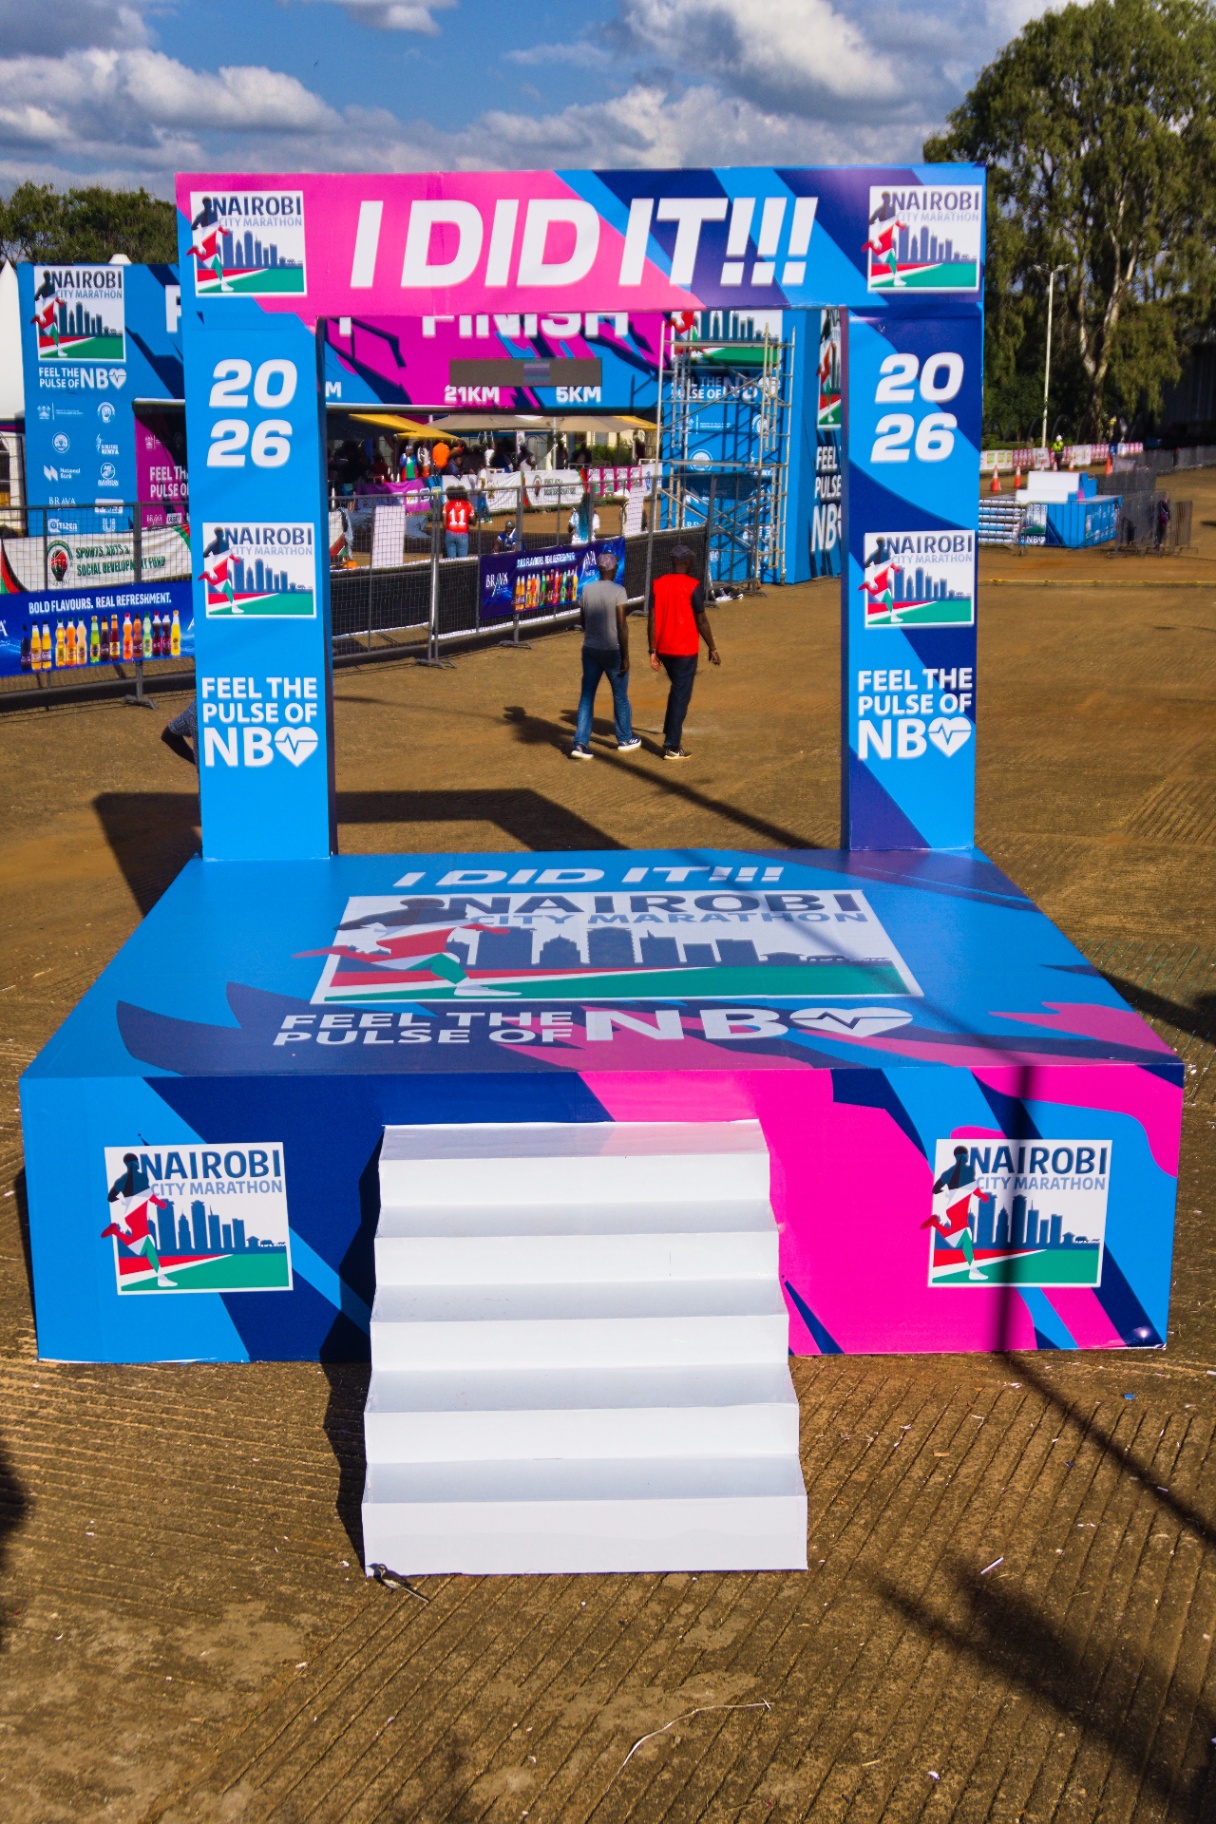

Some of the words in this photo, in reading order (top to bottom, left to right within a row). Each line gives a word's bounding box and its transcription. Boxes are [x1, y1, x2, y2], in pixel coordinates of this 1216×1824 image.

[212, 197, 302, 216] NAIROBI
[892, 191, 980, 211] NAIROBI
[219, 218, 241, 227] CITY
[244, 217, 302, 227] MARATHON
[896, 212, 919, 222] CITY
[921, 212, 980, 222] MARATHON
[350, 200, 384, 289] I
[400, 199, 600, 289] DID
[618, 197, 818, 287] IT!!!
[52, 271, 122, 290] NAIROBI
[56, 290, 74, 299] CITY
[76, 290, 122, 299] MARATHON
[39, 368, 60, 378] FEEL
[62, 368, 79, 378] THE
[700, 376, 721, 387] THE
[875, 352, 965, 404] 20
[40, 378, 64, 388] PULSE
[66, 378, 80, 388] OF
[209, 359, 298, 408] 20
[444, 386, 500, 403] 21KM
[556, 386, 600, 403] 5KM
[706, 388, 721, 399] OF
[207, 419, 293, 468] 26
[870, 412, 958, 463] 26
[816, 446, 837, 471] FEEL
[150, 466, 172, 481] FEEL
[174, 466, 188, 480] TH
[150, 483, 178, 498] PULSE
[814, 475, 841, 499] PULSE
[450, 508, 466, 526] 11
[224, 526, 312, 546] NAIROBI
[886, 535, 972, 554] NAIROBI
[230, 546, 253, 556] CITY
[254, 546, 313, 556] MARATHON
[891, 554, 913, 564] CITY
[915, 553, 972, 564] MARATHON
[76, 562, 102, 576] SOCIAL
[148, 556, 166, 570] FUND
[28, 601, 50, 614] BOLD
[51, 598, 94, 612] FLAVOURS.
[96, 595, 116, 608] REAL
[116, 592, 172, 606] REFRESHMENT.
[202, 677, 262, 699] FEEL
[266, 677, 318, 699] THE
[858, 670, 918, 692] FEEL
[923, 668, 973, 690] THE
[202, 702, 280, 723] PULSE
[284, 702, 318, 723] OF
[858, 694, 934, 716] PULSE
[940, 693, 972, 714] OF
[393, 871, 426, 886] I
[436, 868, 606, 886] DID
[621, 867, 785, 884] IT!!!
[459, 892, 862, 915] NAIROBI
[471, 913, 574, 926] CITY
[602, 912, 870, 925] MARATHON
[280, 1013, 417, 1030] FEEL
[454, 1011, 573, 1028] THE
[273, 1028, 470, 1046] PULSE
[500, 1027, 572, 1044] OF
[139, 1150, 282, 1180] NAIROBI
[969, 1146, 1108, 1175] NAIROBI
[151, 1182, 186, 1196] CITY
[189, 1180, 282, 1196] MARATHON
[976, 1176, 1012, 1190] CITY
[1014, 1176, 1106, 1190] MARATHON
